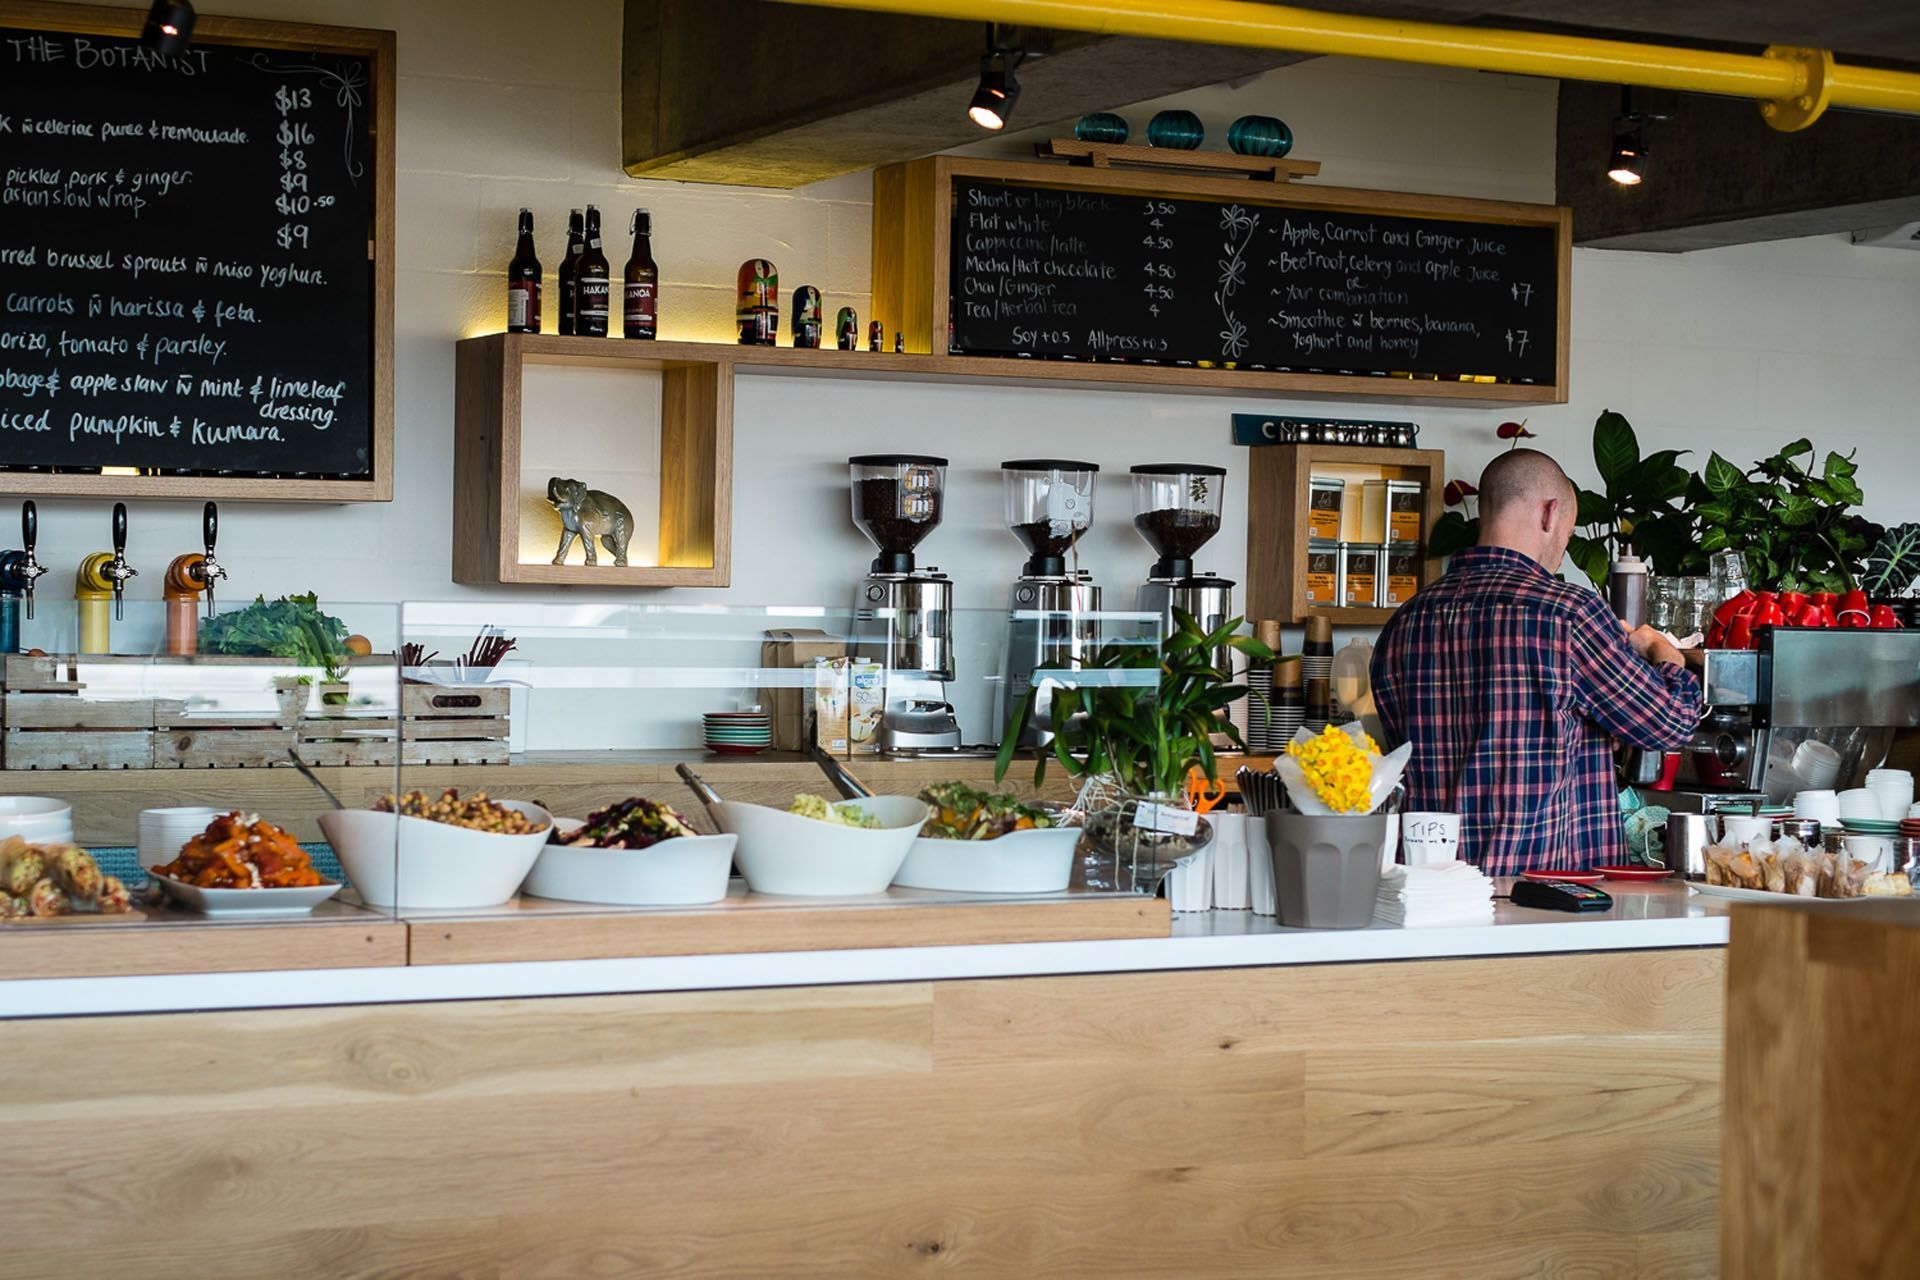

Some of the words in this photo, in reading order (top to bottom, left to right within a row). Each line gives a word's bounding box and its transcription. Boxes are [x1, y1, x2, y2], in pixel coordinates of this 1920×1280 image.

[6, 35, 65, 63] THE
[74, 37, 214, 77] BOTANIST
[274, 84, 313, 117] $13
[35, 118, 94, 137] celeriac
[276, 120, 316, 148] $16
[278, 149, 308, 172] $8
[6, 168, 61, 187] pickled
[68, 170, 109, 189] pork
[130, 168, 193, 197] ginger.
[280, 172, 309, 196] $9
[3, 187, 49, 208] asian
[967, 188, 1014, 208] Short
[968, 211, 1001, 230] Flat
[1004, 213, 1052, 233] white
[1150, 217, 1164, 230] 4
[276, 224, 311, 254] $9
[1325, 220, 1379, 242] Carrot
[1383, 228, 1410, 247] and
[1415, 229, 1464, 254] Ginger
[47, 248, 115, 270] brussel
[121, 253, 188, 279] sprouts
[213, 261, 254, 280] miso
[1511, 282, 1534, 307] $7
[110, 295, 185, 319] harissa
[213, 300, 262, 328] feta.
[1148, 303, 1161, 318] 4
[1278, 309, 1345, 328] Smoothie
[58, 329, 129, 357] tomato
[154, 333, 228, 366] parsley.
[1011, 326, 1038, 348] Soy
[1347, 334, 1373, 350] and
[70, 373, 118, 397] apple
[121, 373, 169, 394] slaw
[200, 377, 244, 398] mint
[259, 399, 338, 430] dressing.
[69, 411, 166, 445] pumpkin
[1410, 821, 1446, 837] TIPS
